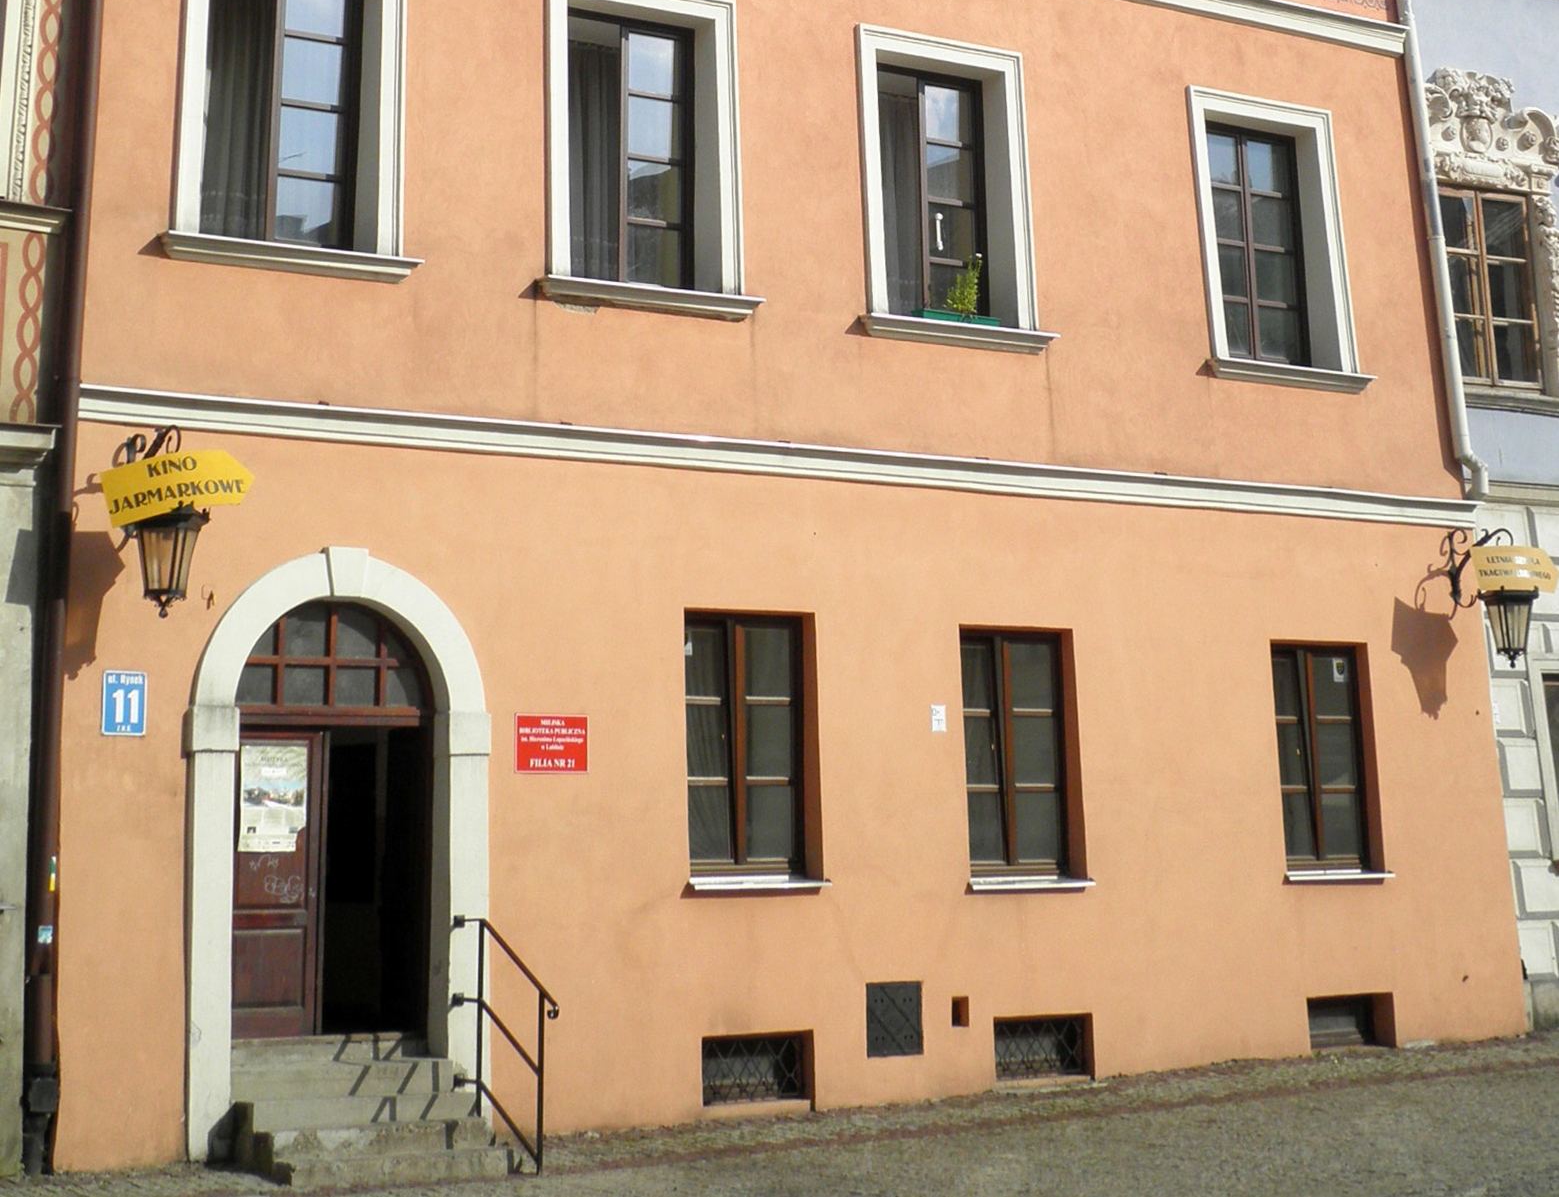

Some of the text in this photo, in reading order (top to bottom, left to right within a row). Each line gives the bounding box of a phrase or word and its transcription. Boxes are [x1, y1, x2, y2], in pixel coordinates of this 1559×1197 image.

[146, 456, 197, 478] KINO
[109, 479, 245, 515] JARMARKOWE
[120, 674, 144, 686] Rynek
[112, 689, 139, 723] 11
[554, 727, 585, 735] PUBLICZNA
[529, 758, 575, 768] FILIA NR 21
